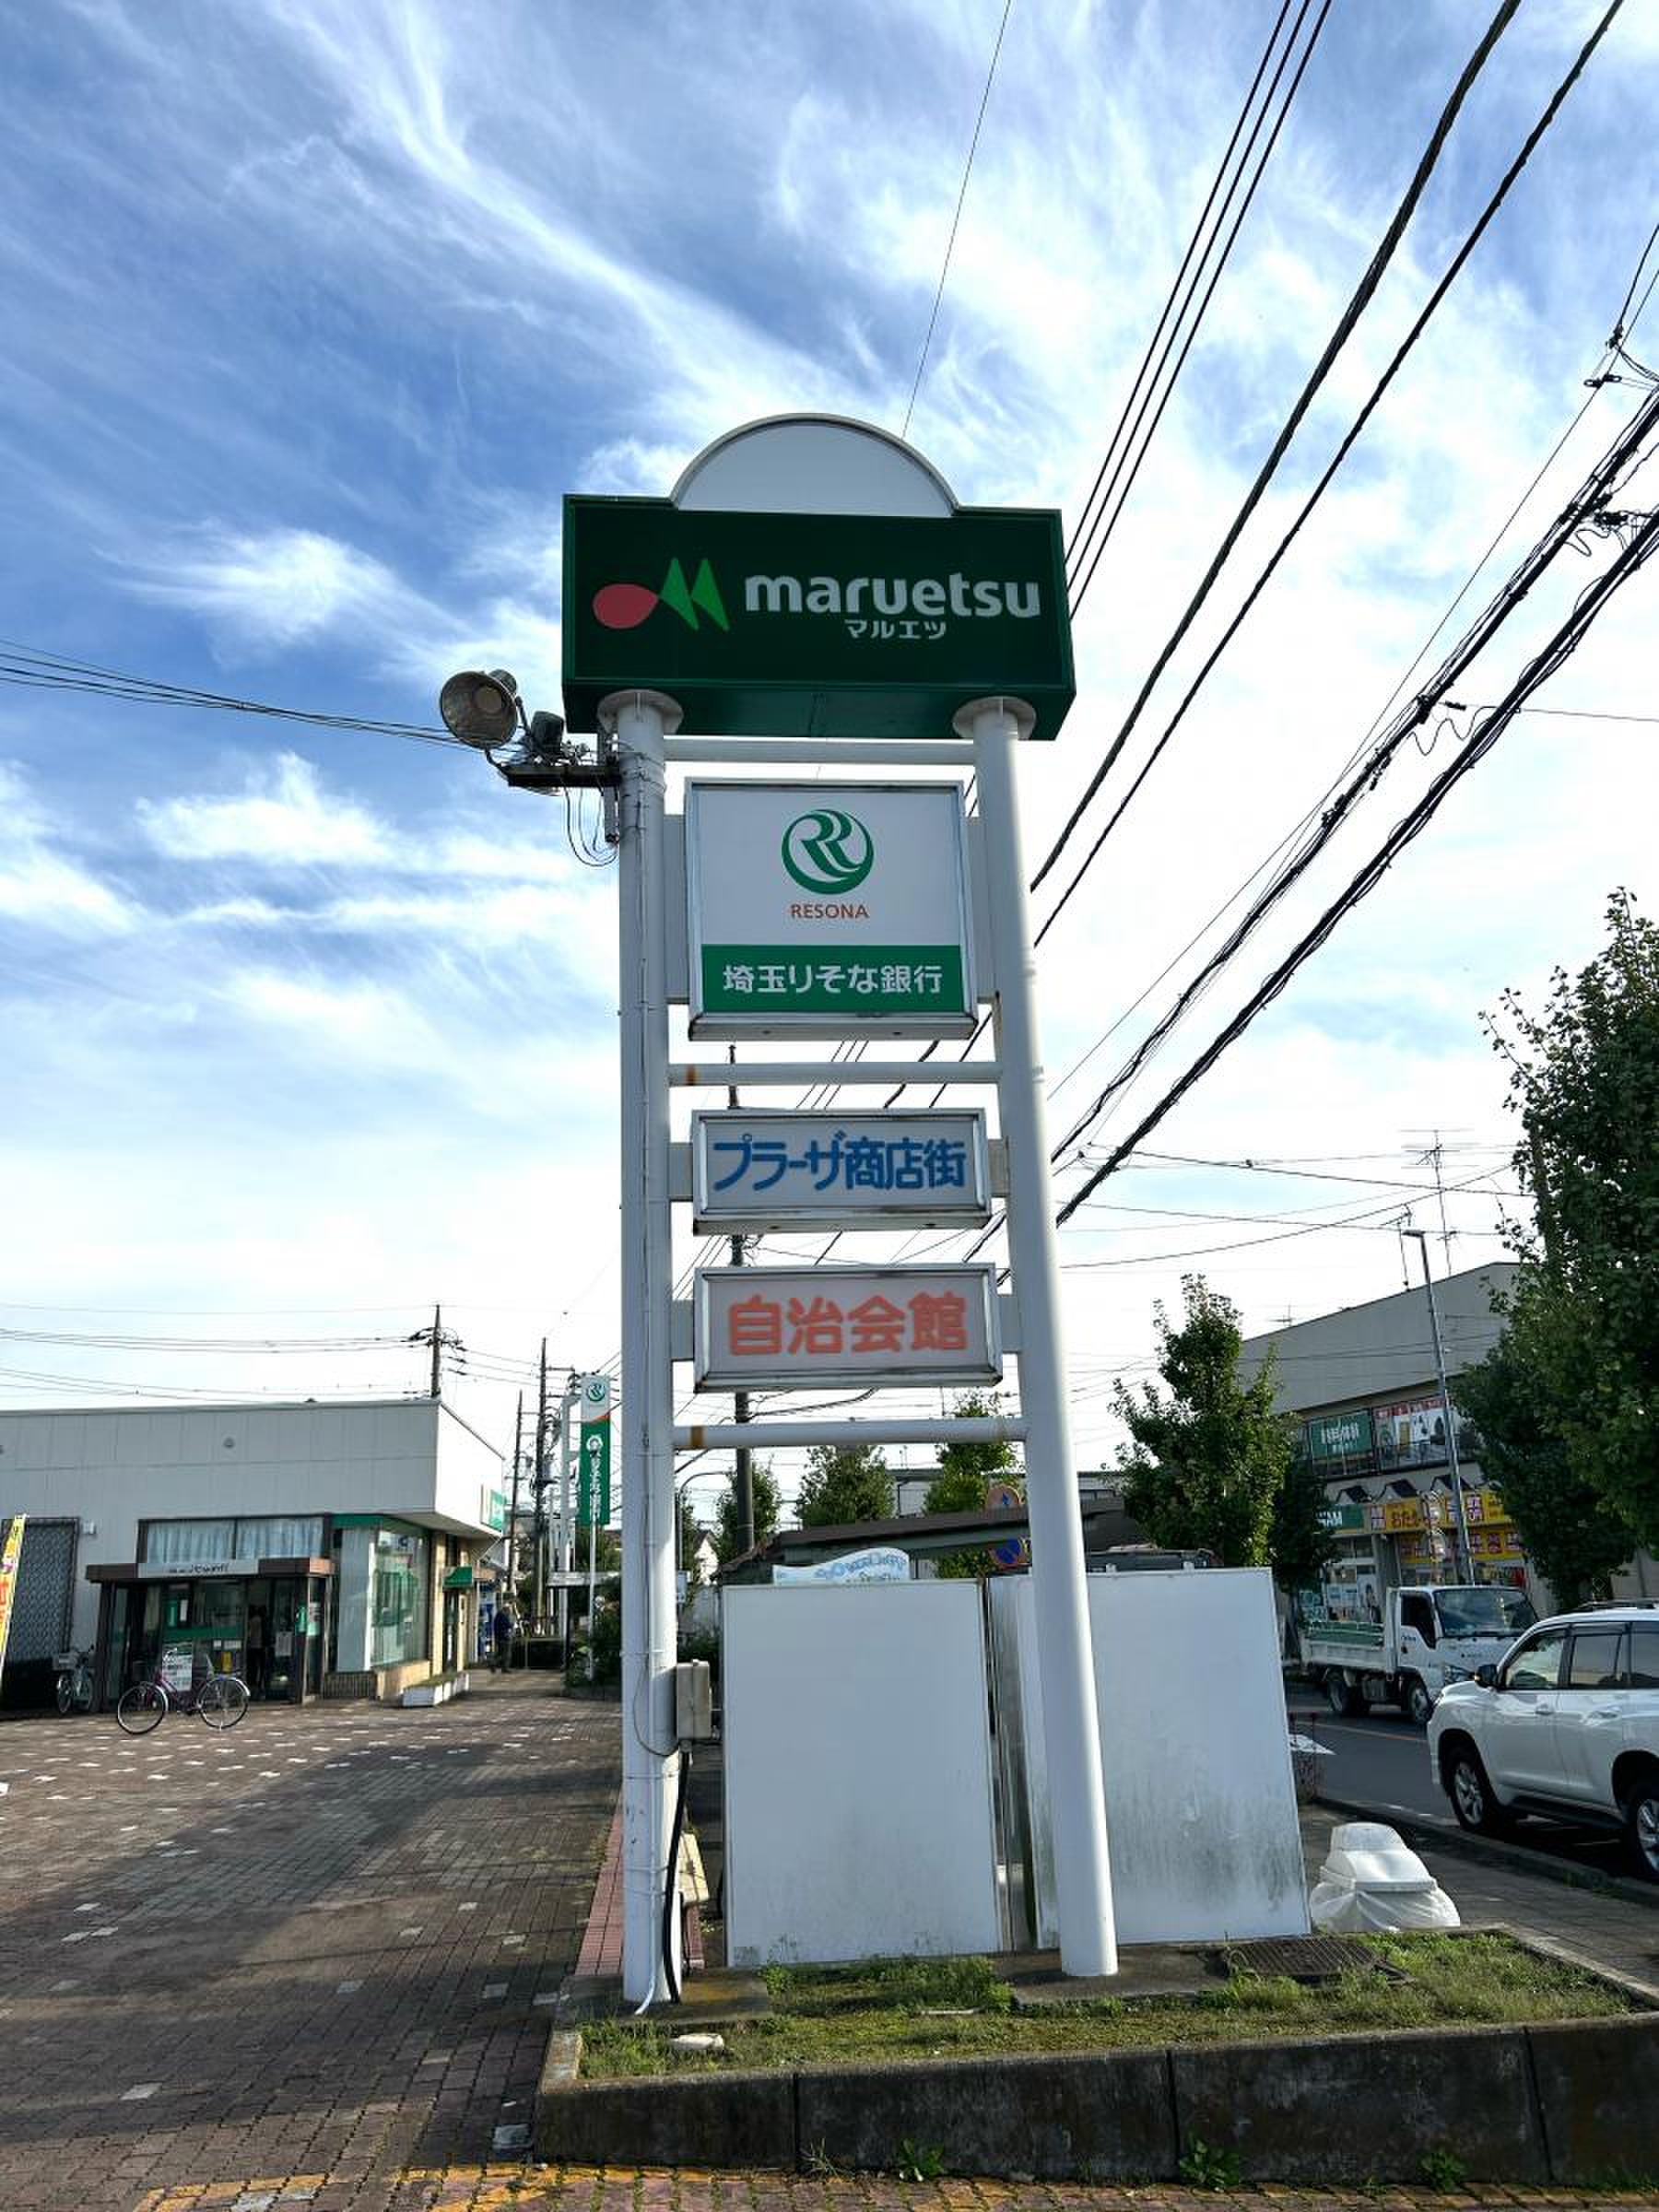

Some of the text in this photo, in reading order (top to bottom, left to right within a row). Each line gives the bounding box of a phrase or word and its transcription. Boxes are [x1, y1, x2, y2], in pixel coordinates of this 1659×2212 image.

[744, 572, 1041, 618] maruetsu
[844, 618, 947, 641] マルエツ
[790, 902, 869, 920] RESONA
[723, 964, 944, 994] 埼玉りそな銀行
[713, 1130, 967, 1191] プラーザ商店街
[728, 1291, 968, 1356] 自治会館
